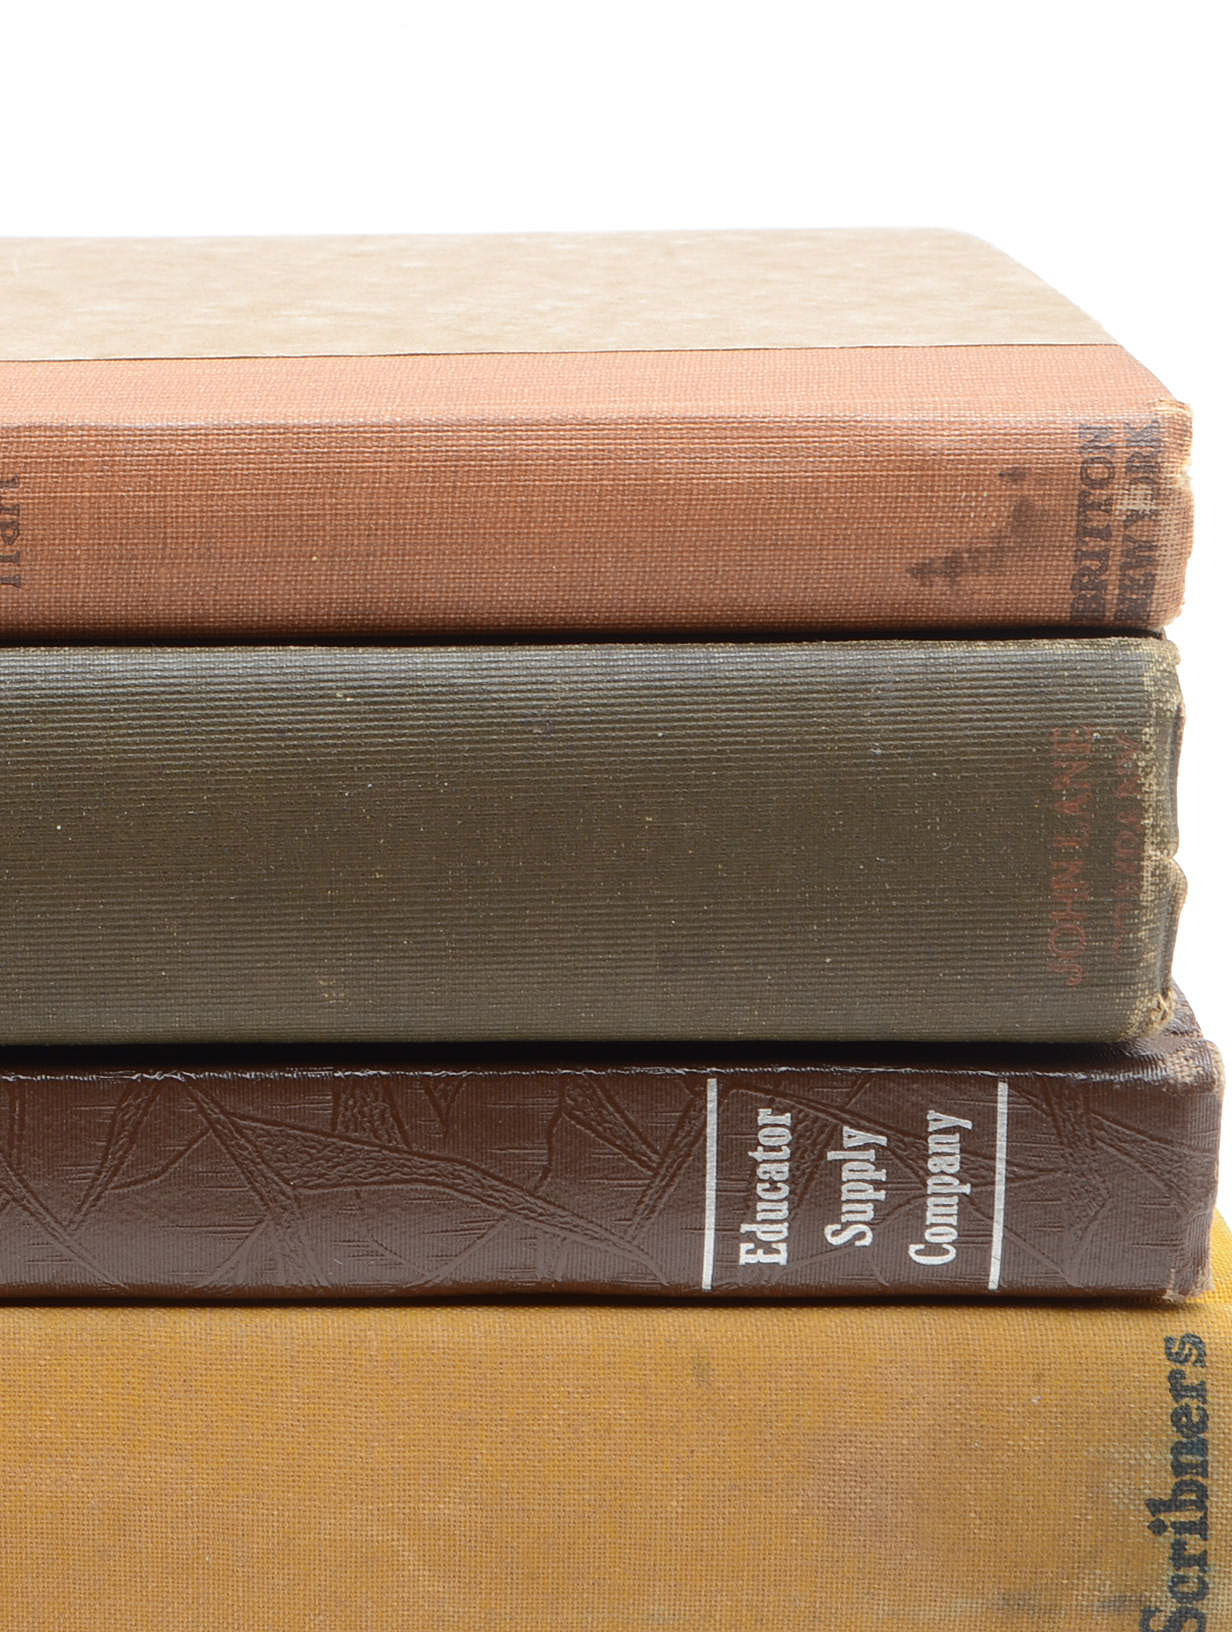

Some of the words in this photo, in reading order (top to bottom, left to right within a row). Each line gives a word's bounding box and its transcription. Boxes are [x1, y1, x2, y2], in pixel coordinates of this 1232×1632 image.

[1052, 724, 1095, 850] LANE
[1048, 860, 1089, 986] JOHN
[738, 1108, 792, 1266] Educator
[823, 1125, 888, 1247] Supply
[907, 1109, 973, 1266] Company
[1139, 1332, 1210, 1632] Scribners
